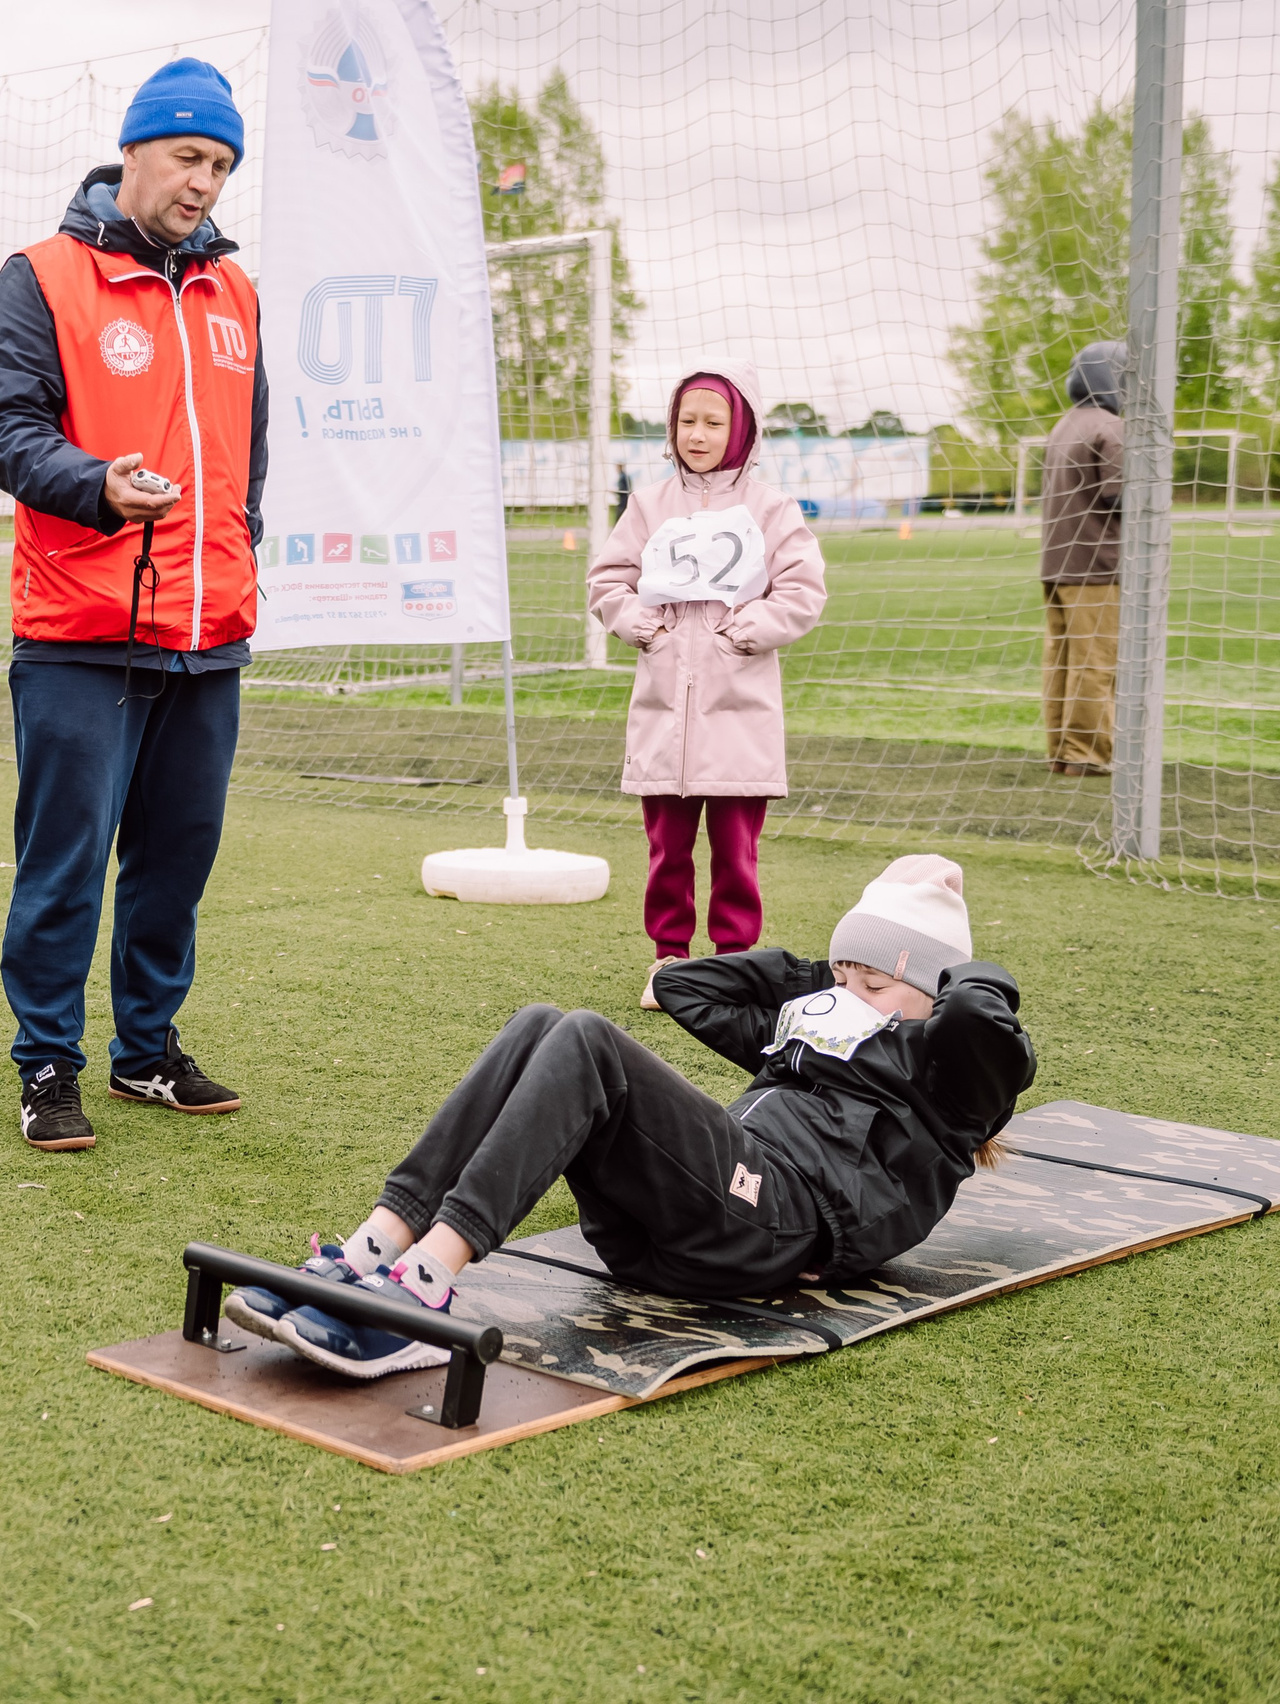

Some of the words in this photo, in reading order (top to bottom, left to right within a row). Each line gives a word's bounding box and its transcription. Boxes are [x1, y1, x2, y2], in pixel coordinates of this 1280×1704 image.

[121, 352, 136, 360] ГТО
[206, 312, 247, 360] ГТО
[669, 531, 743, 592] 52
